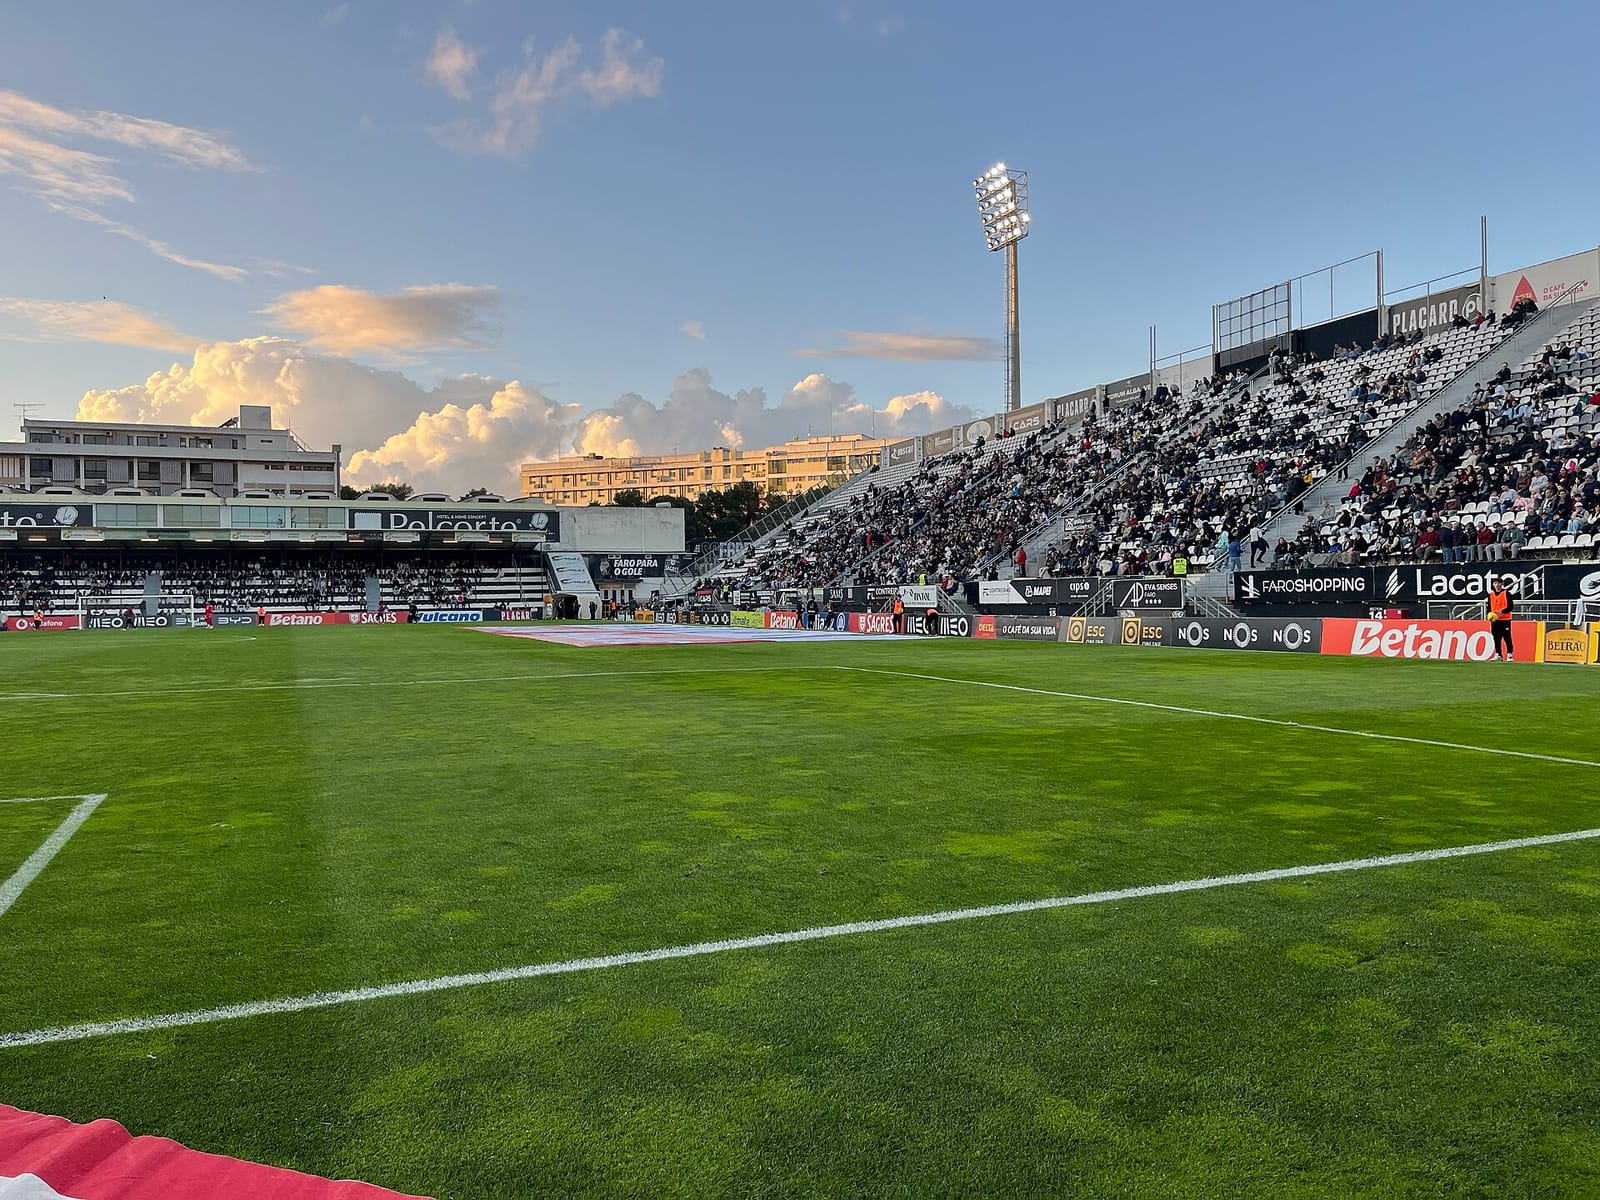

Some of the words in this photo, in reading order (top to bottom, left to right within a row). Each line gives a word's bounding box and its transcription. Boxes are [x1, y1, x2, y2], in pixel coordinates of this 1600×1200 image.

[1393, 299, 1457, 335] PLACARD
[1013, 416, 1039, 430] CARS
[613, 559, 635, 568] FARO
[636, 559, 658, 568] PARA
[614, 567, 621, 576] O
[621, 567, 643, 576] GOLE
[1144, 583, 1156, 591] EVA
[1156, 582, 1178, 591] SENSES
[270, 613, 323, 626] Betano
[866, 614, 894, 633] SAGRES
[940, 617, 968, 636] MEO
[978, 623, 994, 632] DELTA
[1002, 625, 1007, 633] O
[1022, 625, 1030, 634] DA
[1030, 626, 1042, 635] SUA
[1042, 626, 1057, 636] VIDA
[1087, 626, 1106, 637] ESC
[1142, 627, 1162, 638] ESC
[1178, 621, 1209, 646] NOS
[1223, 622, 1258, 648] NOS
[1273, 622, 1311, 650] NOS
[1351, 621, 1495, 661] Betano
